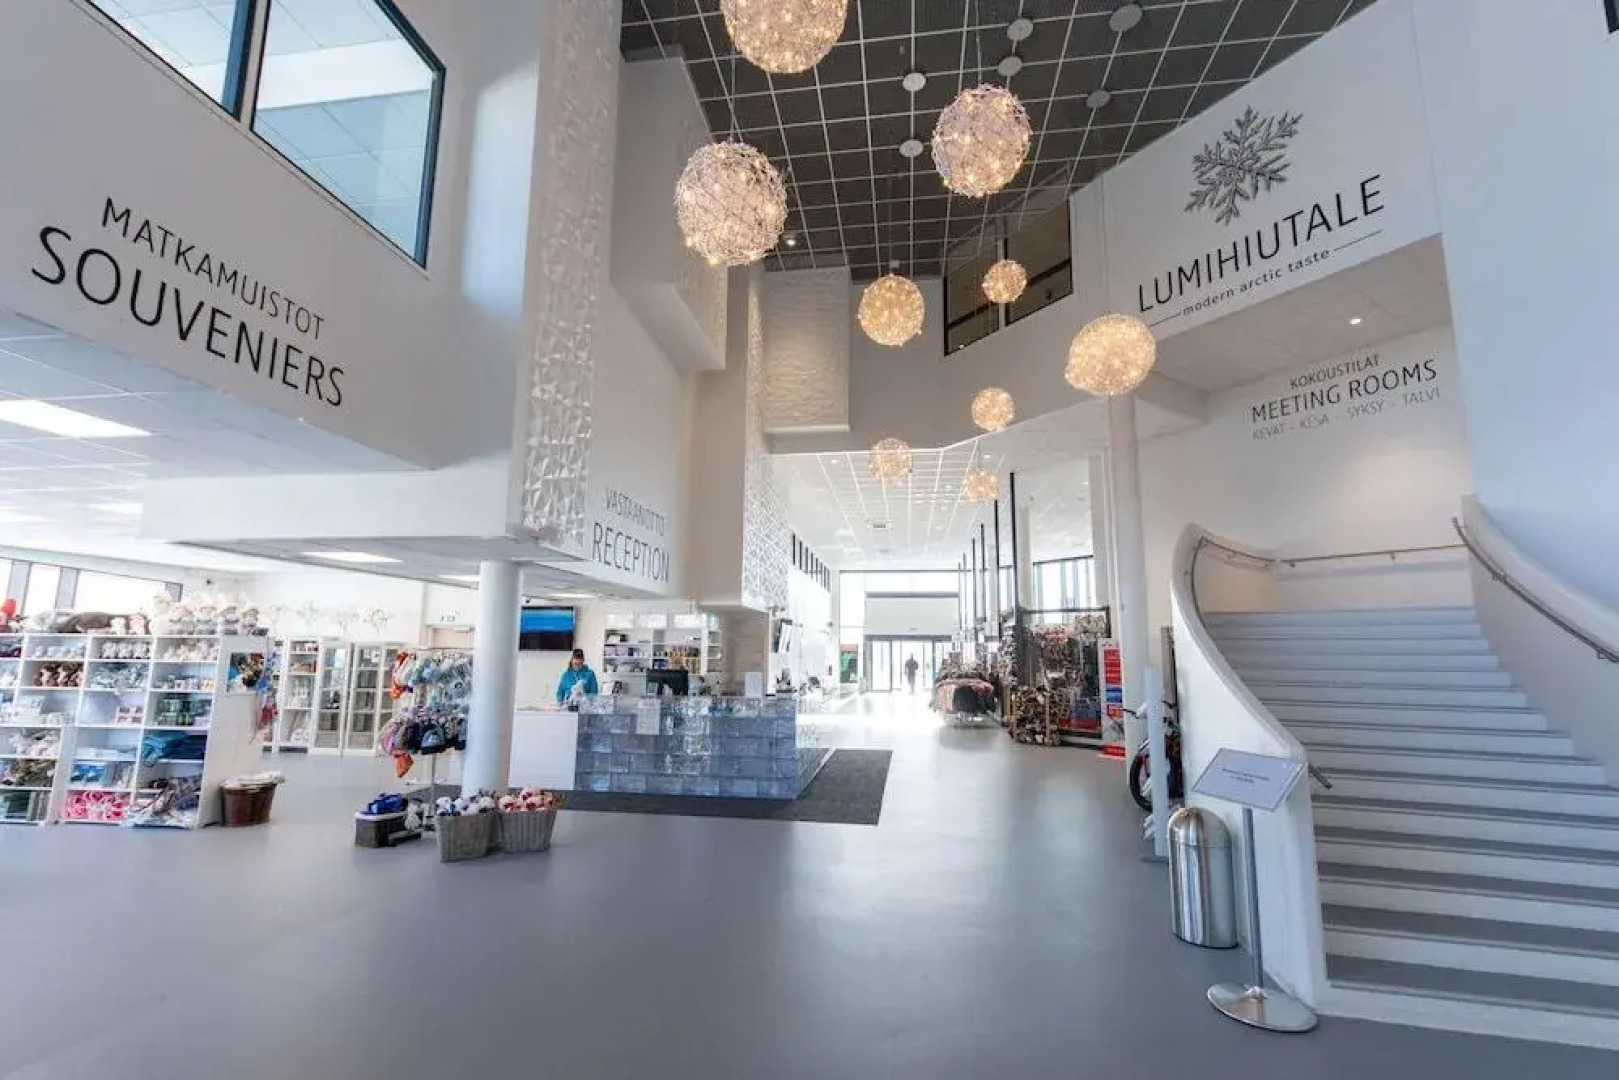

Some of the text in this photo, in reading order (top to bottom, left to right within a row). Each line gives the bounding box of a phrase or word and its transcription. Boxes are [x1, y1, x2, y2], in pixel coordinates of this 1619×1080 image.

[101, 196, 325, 340] MATKAMUISTOT
[1138, 174, 1385, 313] LUMIHIUTALE
[1183, 249, 1331, 316] modern arctic taste
[31, 226, 345, 407] SOUVENIERS
[1252, 358, 1438, 424] MEETING ROOMS
[1290, 353, 1380, 390] KOKOUSTILAT
[1403, 386, 1441, 409] TALVI
[592, 521, 670, 583] RECEPTION
